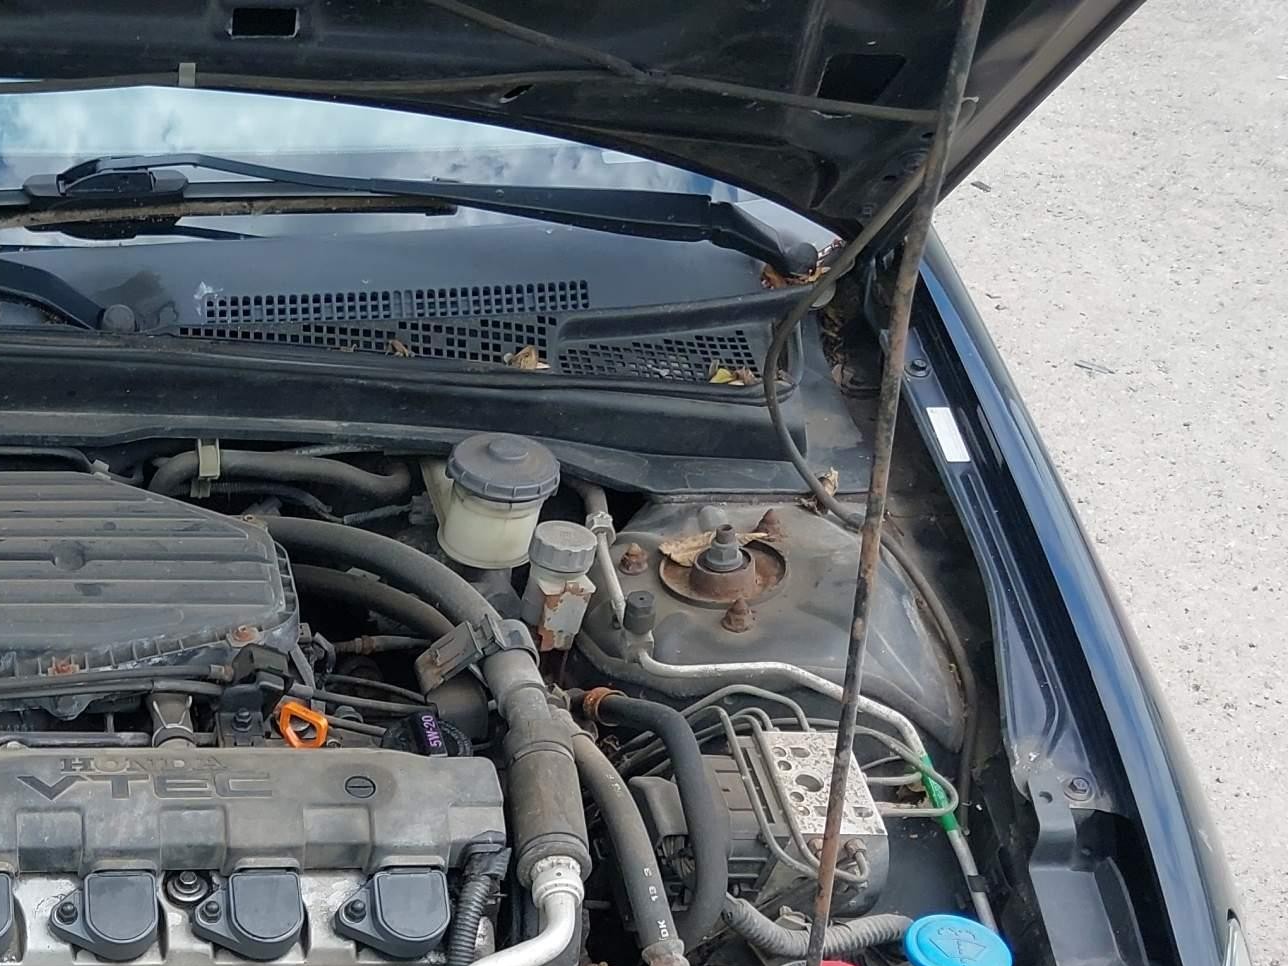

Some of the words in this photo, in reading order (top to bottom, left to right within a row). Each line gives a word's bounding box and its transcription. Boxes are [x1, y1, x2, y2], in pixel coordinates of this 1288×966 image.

[421, 714, 442, 748] 5W-20
[61, 757, 227, 774] HONDA
[16, 774, 273, 801] VTEC
